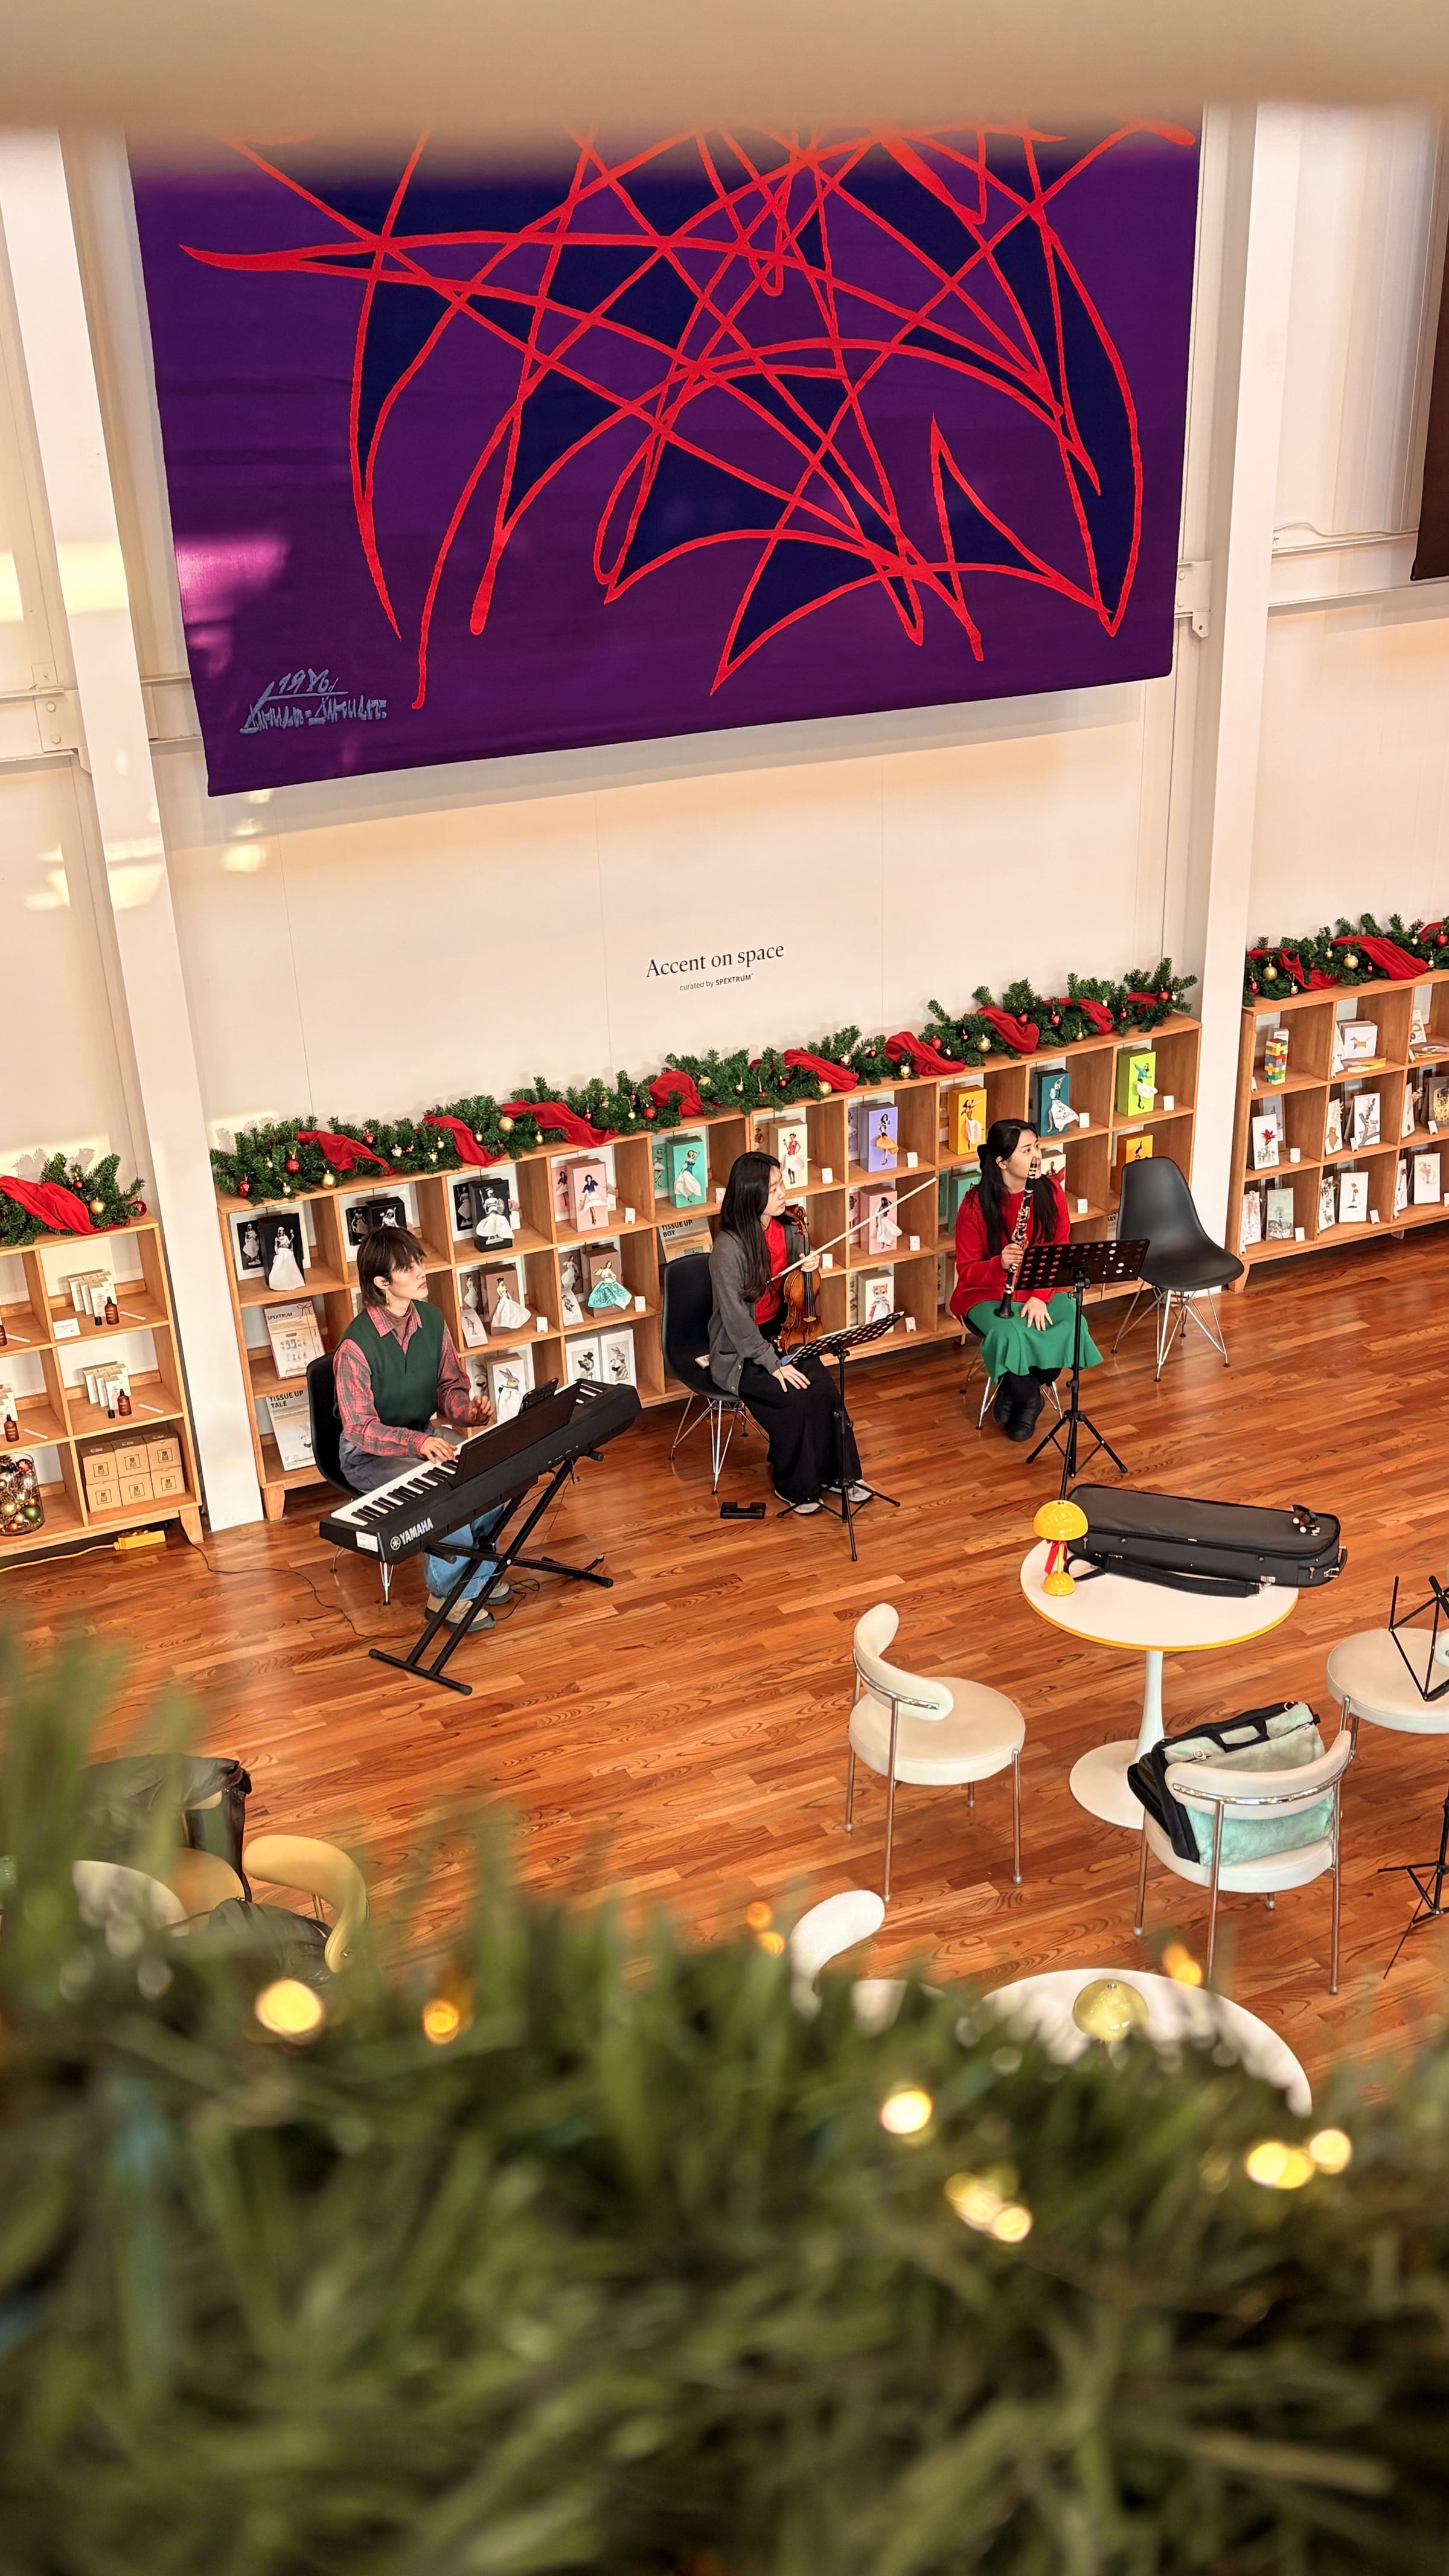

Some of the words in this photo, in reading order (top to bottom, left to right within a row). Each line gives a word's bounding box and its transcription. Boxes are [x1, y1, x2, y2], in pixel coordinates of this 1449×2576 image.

[645, 959, 706, 978] Accent
[711, 953, 732, 967] on
[737, 944, 784, 967] space
[679, 981, 705, 991] curated
[715, 975, 752, 986] SPEXTRUM
[661, 1221, 683, 1231] TISSUE
[269, 1392, 293, 1402] TISSUE
[270, 1400, 287, 1409] TALE
[400, 1517, 434, 1545] YAMAHA
